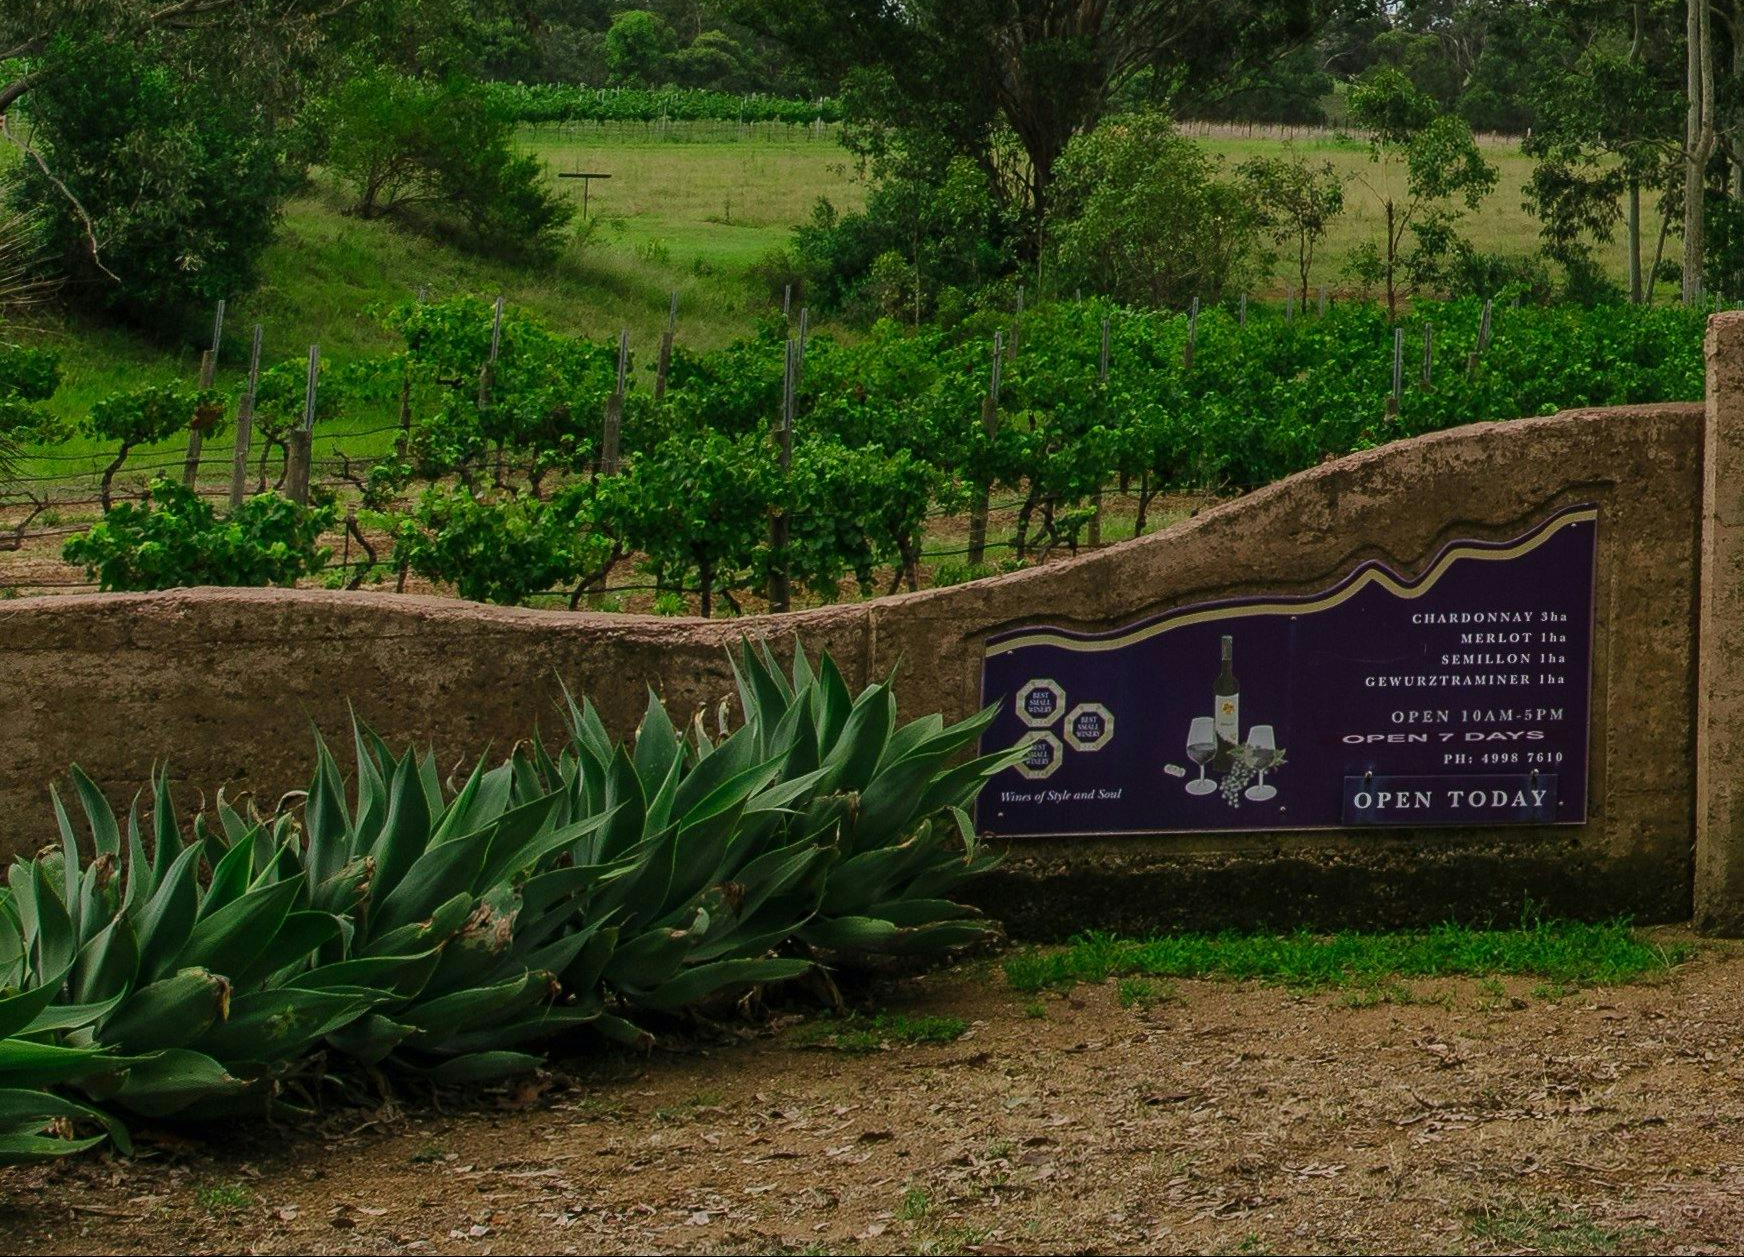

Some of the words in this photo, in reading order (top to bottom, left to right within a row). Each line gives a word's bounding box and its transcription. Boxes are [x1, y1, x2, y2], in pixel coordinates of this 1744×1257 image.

[1412, 611, 1533, 624] CHARDONNAY
[1540, 611, 1567, 622] 3ha
[1461, 632, 1533, 644] MERLOT
[1441, 653, 1531, 665] SEMILLON
[1365, 674, 1530, 687] GEWURZTRAMINER
[1391, 710, 1449, 724] OPEN
[1461, 708, 1564, 722] 10AM-5PM
[1342, 733, 1428, 744] OPEN
[1438, 733, 1455, 742] 7
[1465, 731, 1545, 742] DAYS
[1443, 753, 1473, 764] PH:
[1481, 752, 1518, 764] 4998
[1527, 752, 1563, 763] 7610
[1001, 791, 1032, 802] Wines
[1034, 789, 1046, 804] of
[1047, 789, 1072, 804] Style
[1073, 788, 1095, 800] and
[1098, 788, 1122, 800] Soul
[1353, 791, 1432, 809] OPEN
[1447, 790, 1547, 808] TODAY
